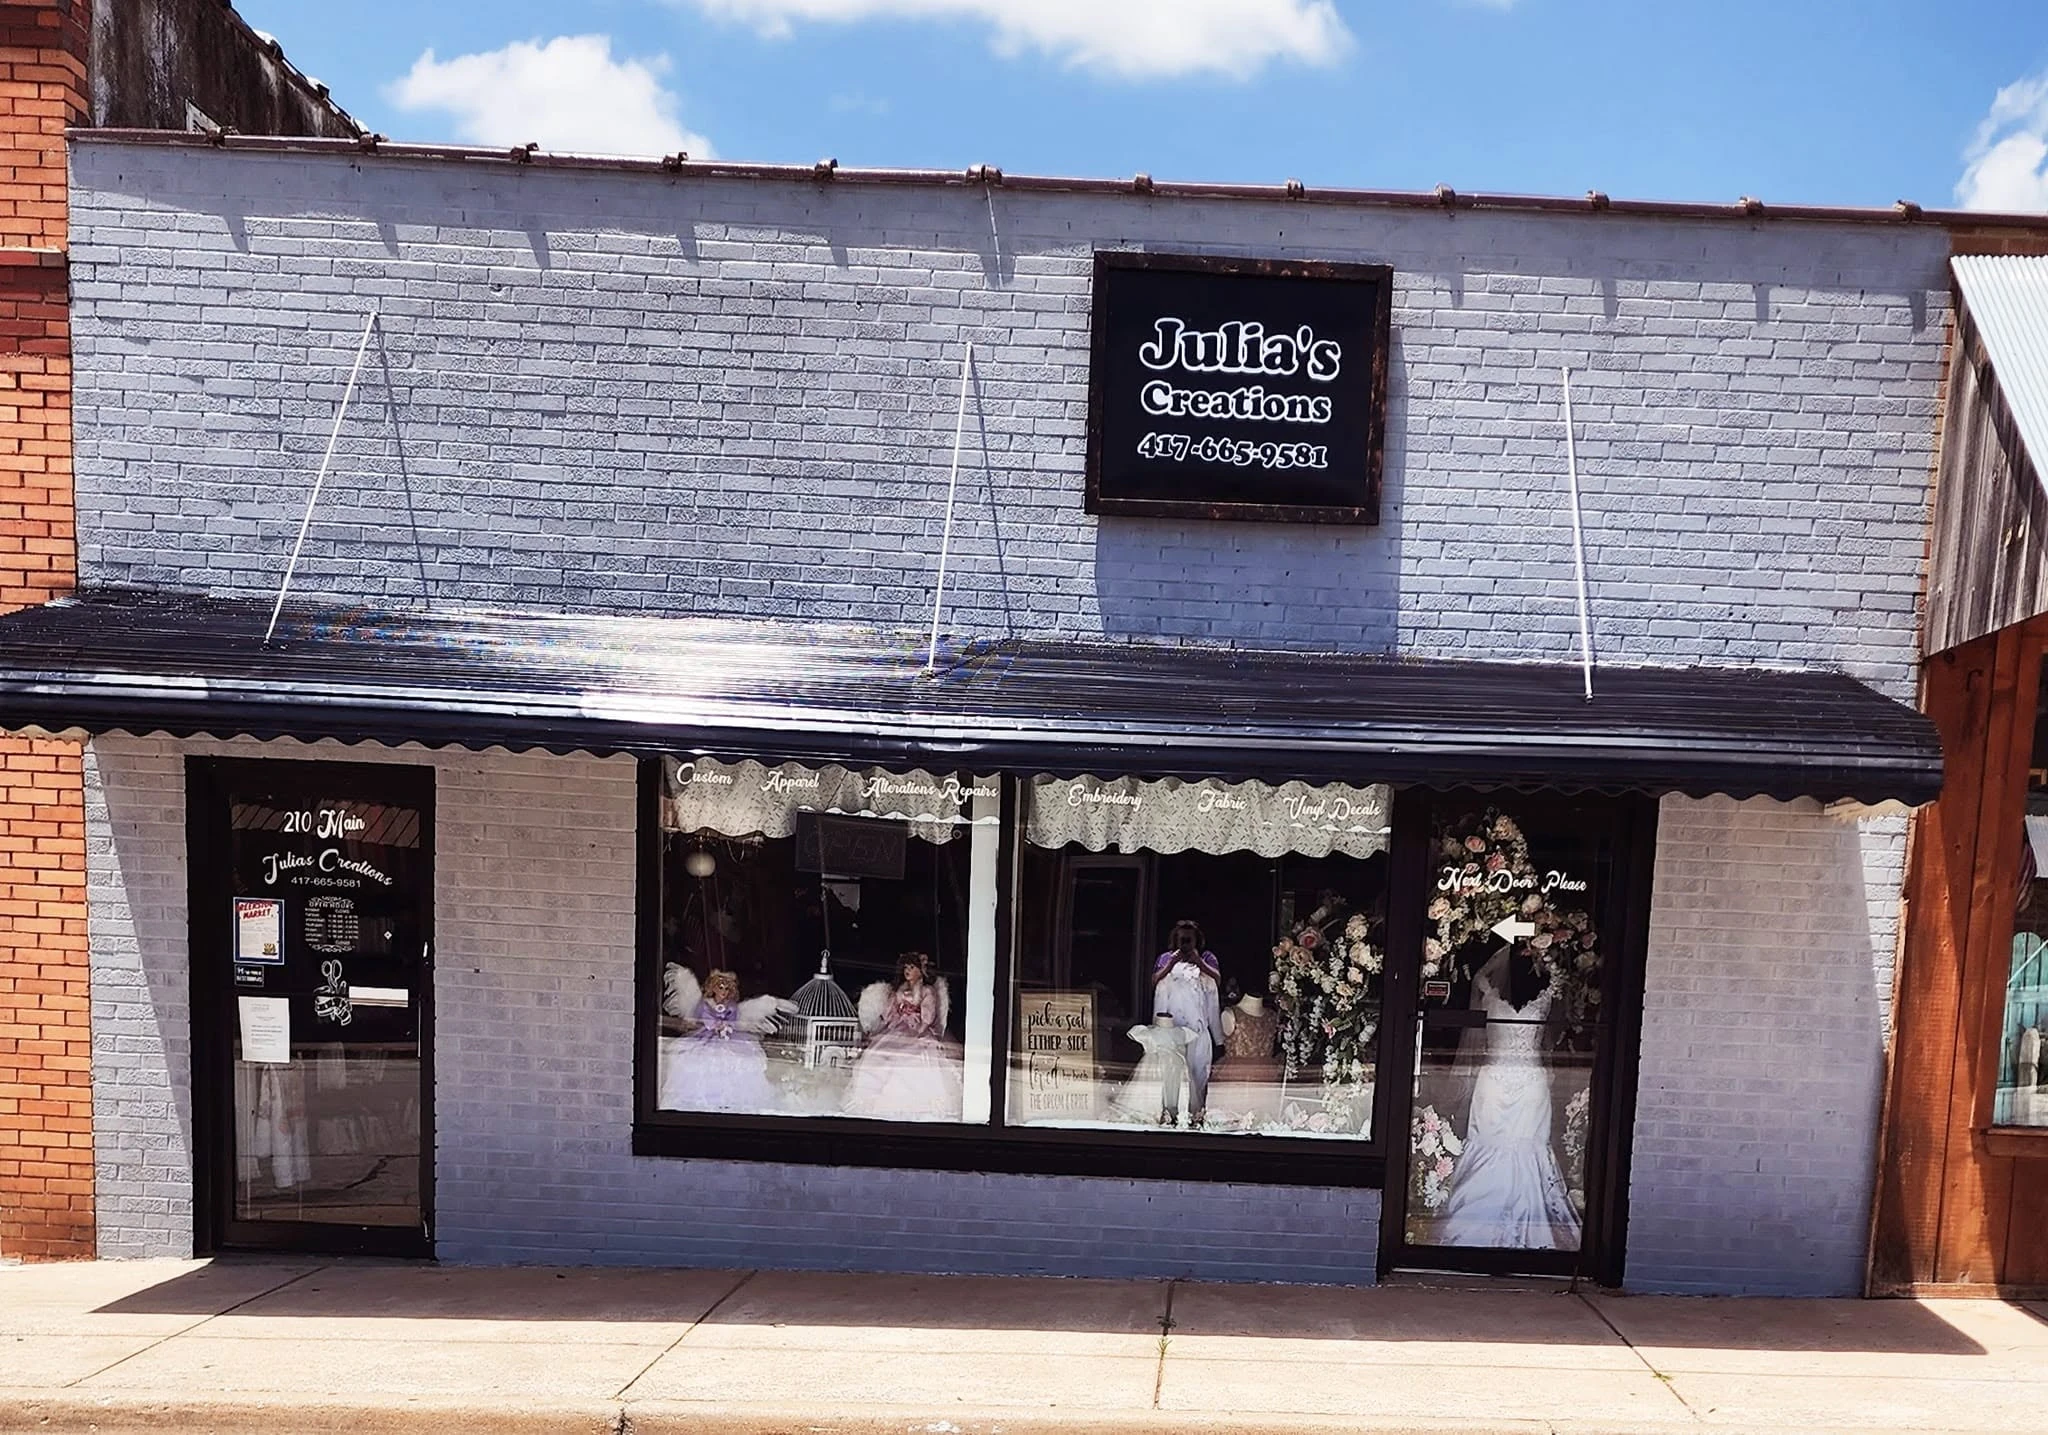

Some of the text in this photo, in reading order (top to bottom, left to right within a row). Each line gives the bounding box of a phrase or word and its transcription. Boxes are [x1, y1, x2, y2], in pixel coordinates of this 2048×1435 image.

[1139, 317, 1341, 380] Julia's
[1140, 380, 1331, 423] Creations
[1137, 432, 1328, 468] 417-665-9581
[676, 762, 999, 805] Custom Apparel Alterations Repairs
[1068, 783, 1381, 821] Embroidery Fabric Vinyl Decals
[283, 809, 366, 839] 210 Main
[262, 848, 393, 886] Julias Creations
[290, 876, 361, 888] 417-665-9581
[1437, 866, 1588, 893] Next Door Please
[1027, 1001, 1052, 1034] pick
[1055, 1014, 1063, 1028] a
[1027, 1034, 1088, 1051] EITHER SIDE
